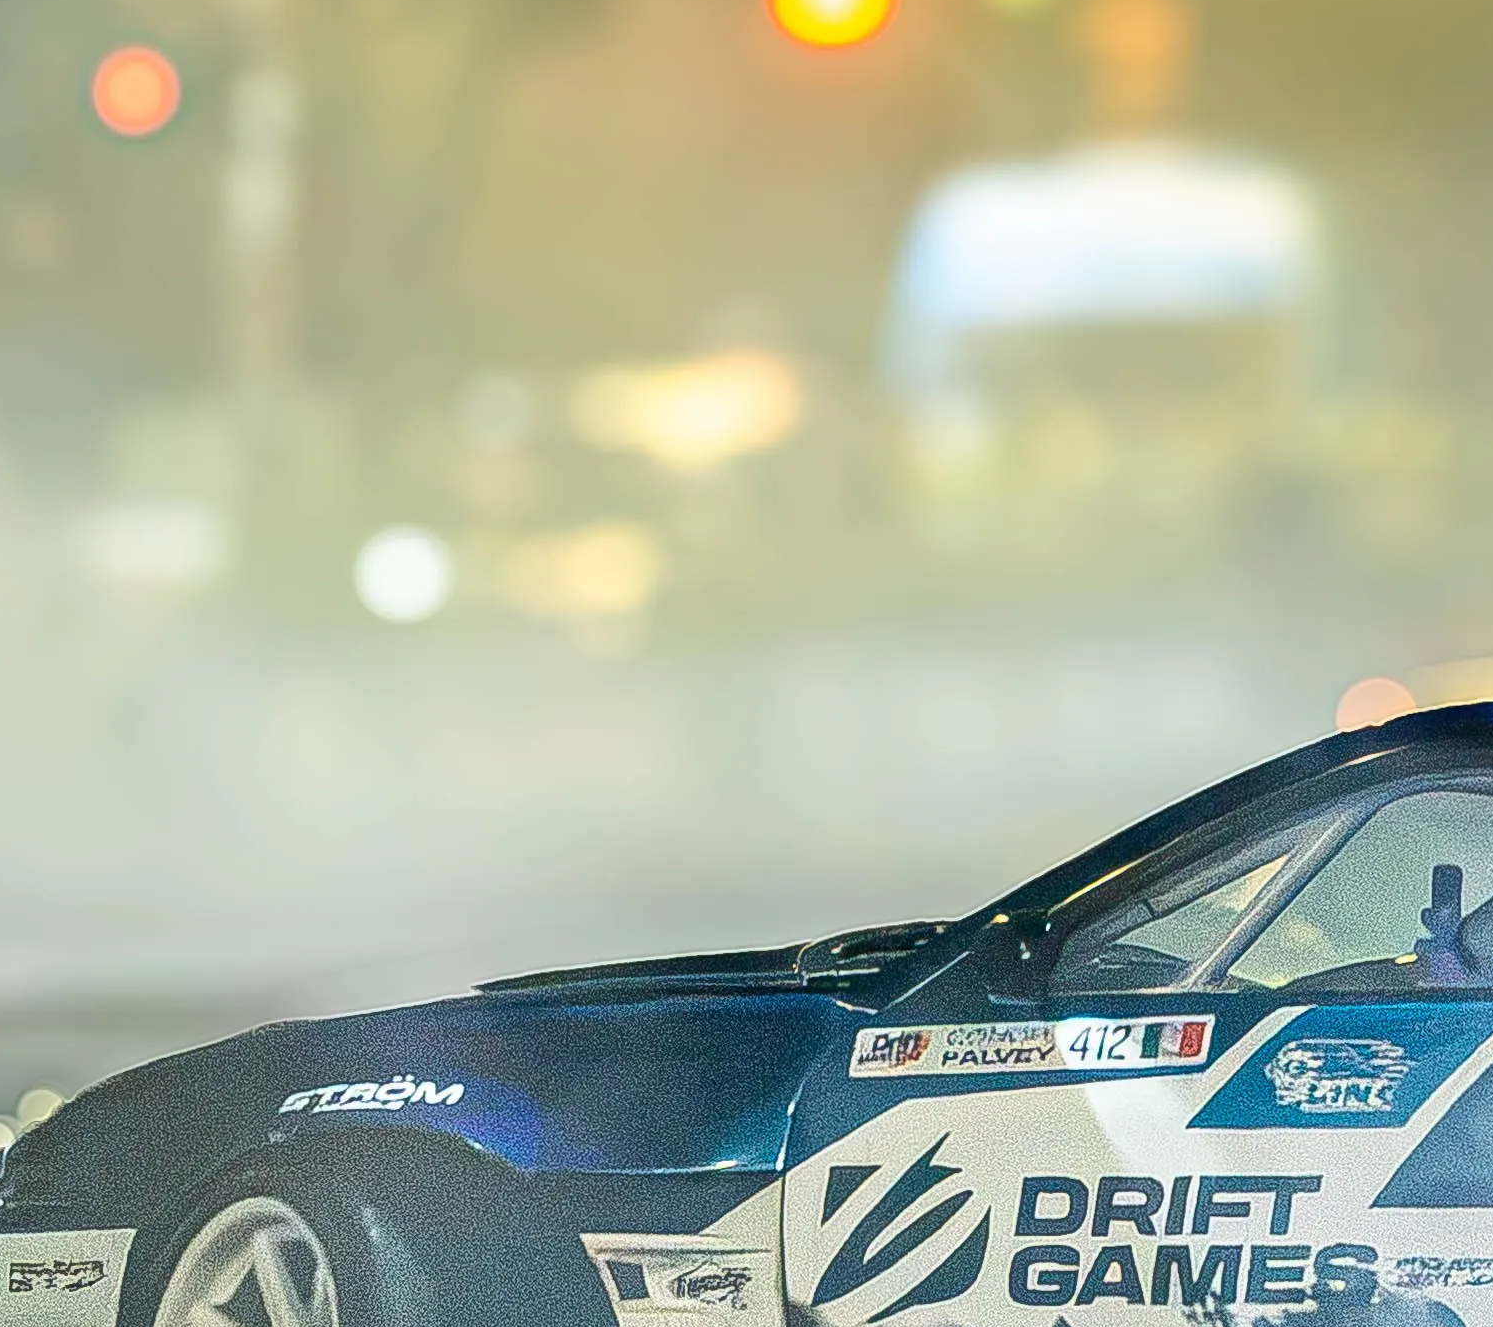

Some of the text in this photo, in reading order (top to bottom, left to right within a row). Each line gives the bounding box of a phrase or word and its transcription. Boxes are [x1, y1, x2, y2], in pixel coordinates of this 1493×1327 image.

[1068, 1024, 1131, 1061] 412
[1014, 1175, 1324, 1237] DRIFT
[1009, 1242, 1380, 1306] GAMES
